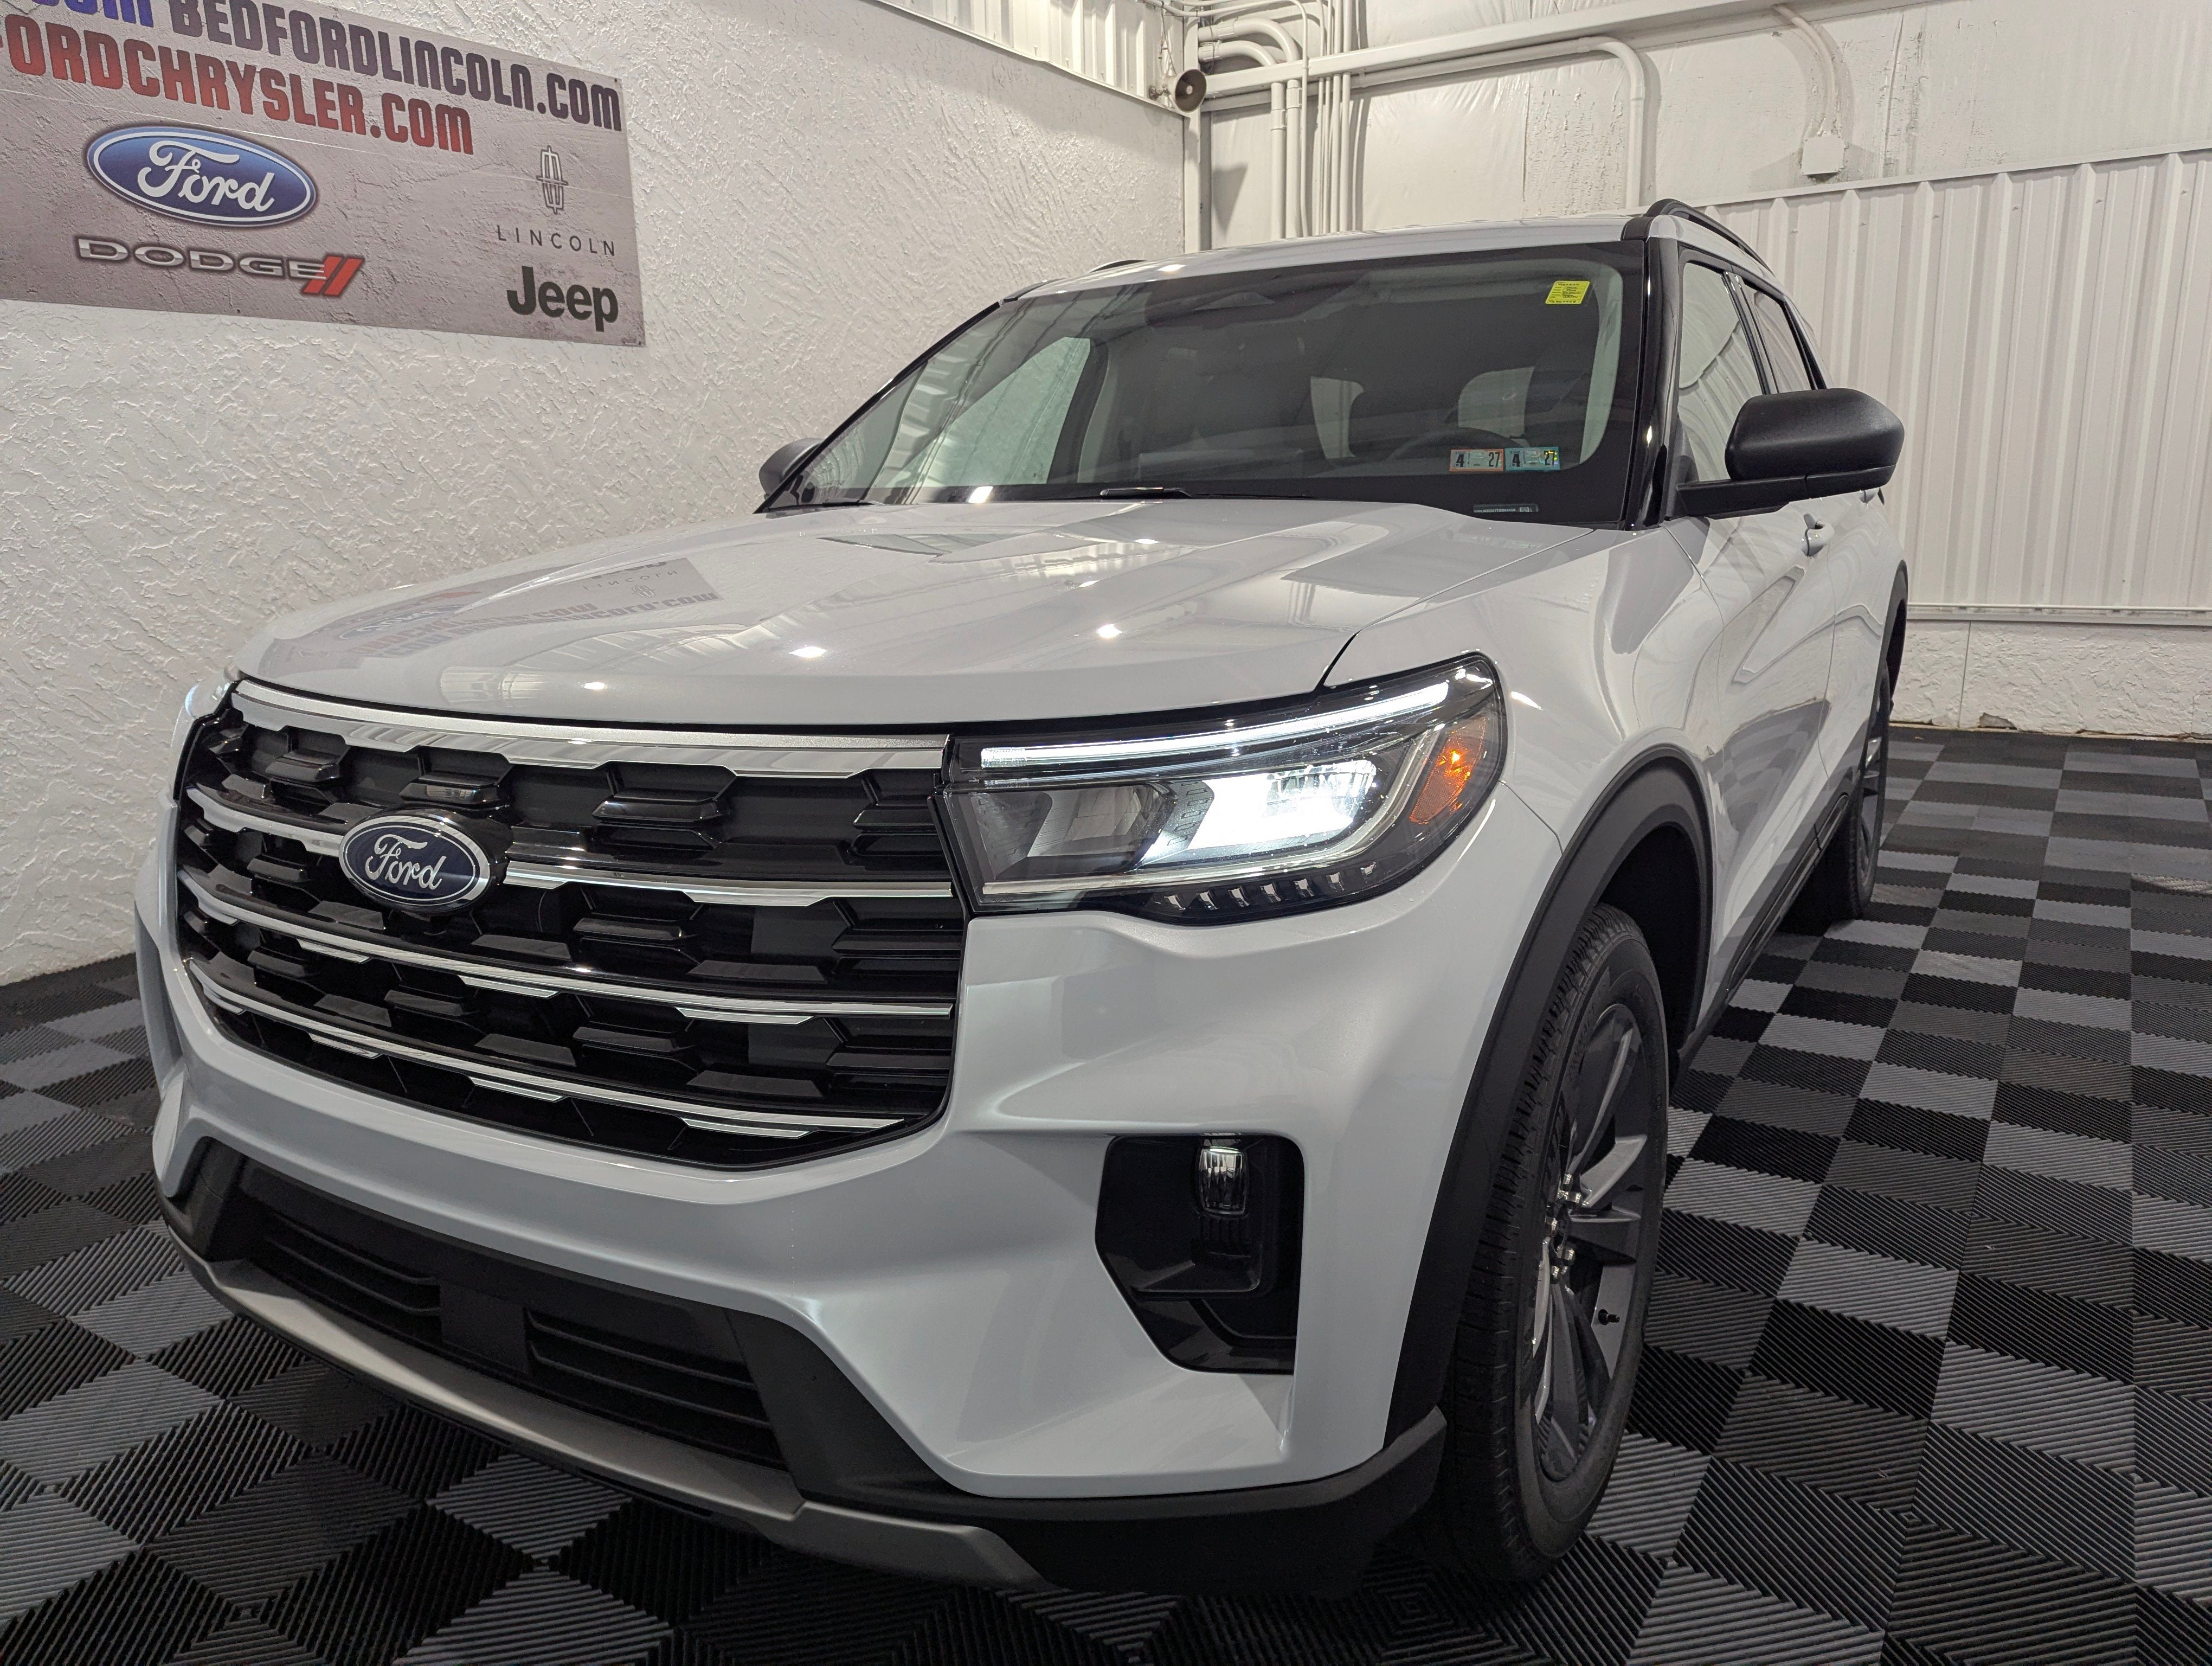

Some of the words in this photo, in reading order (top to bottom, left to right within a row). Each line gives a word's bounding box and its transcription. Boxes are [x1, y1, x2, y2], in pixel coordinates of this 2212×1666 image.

[0, 14, 473, 155] ORDCHRYSLER.COM
[137, 140, 275, 212] Ford
[78, 239, 327, 280] DODGE
[497, 225, 615, 257] LINCOLN
[506, 266, 619, 332] Jeep
[1456, 453, 1464, 467] 4
[1488, 451, 1500, 469] 27
[1512, 453, 1521, 467] 4
[1544, 450, 1555, 466] 27
[365, 834, 447, 889] Ford
